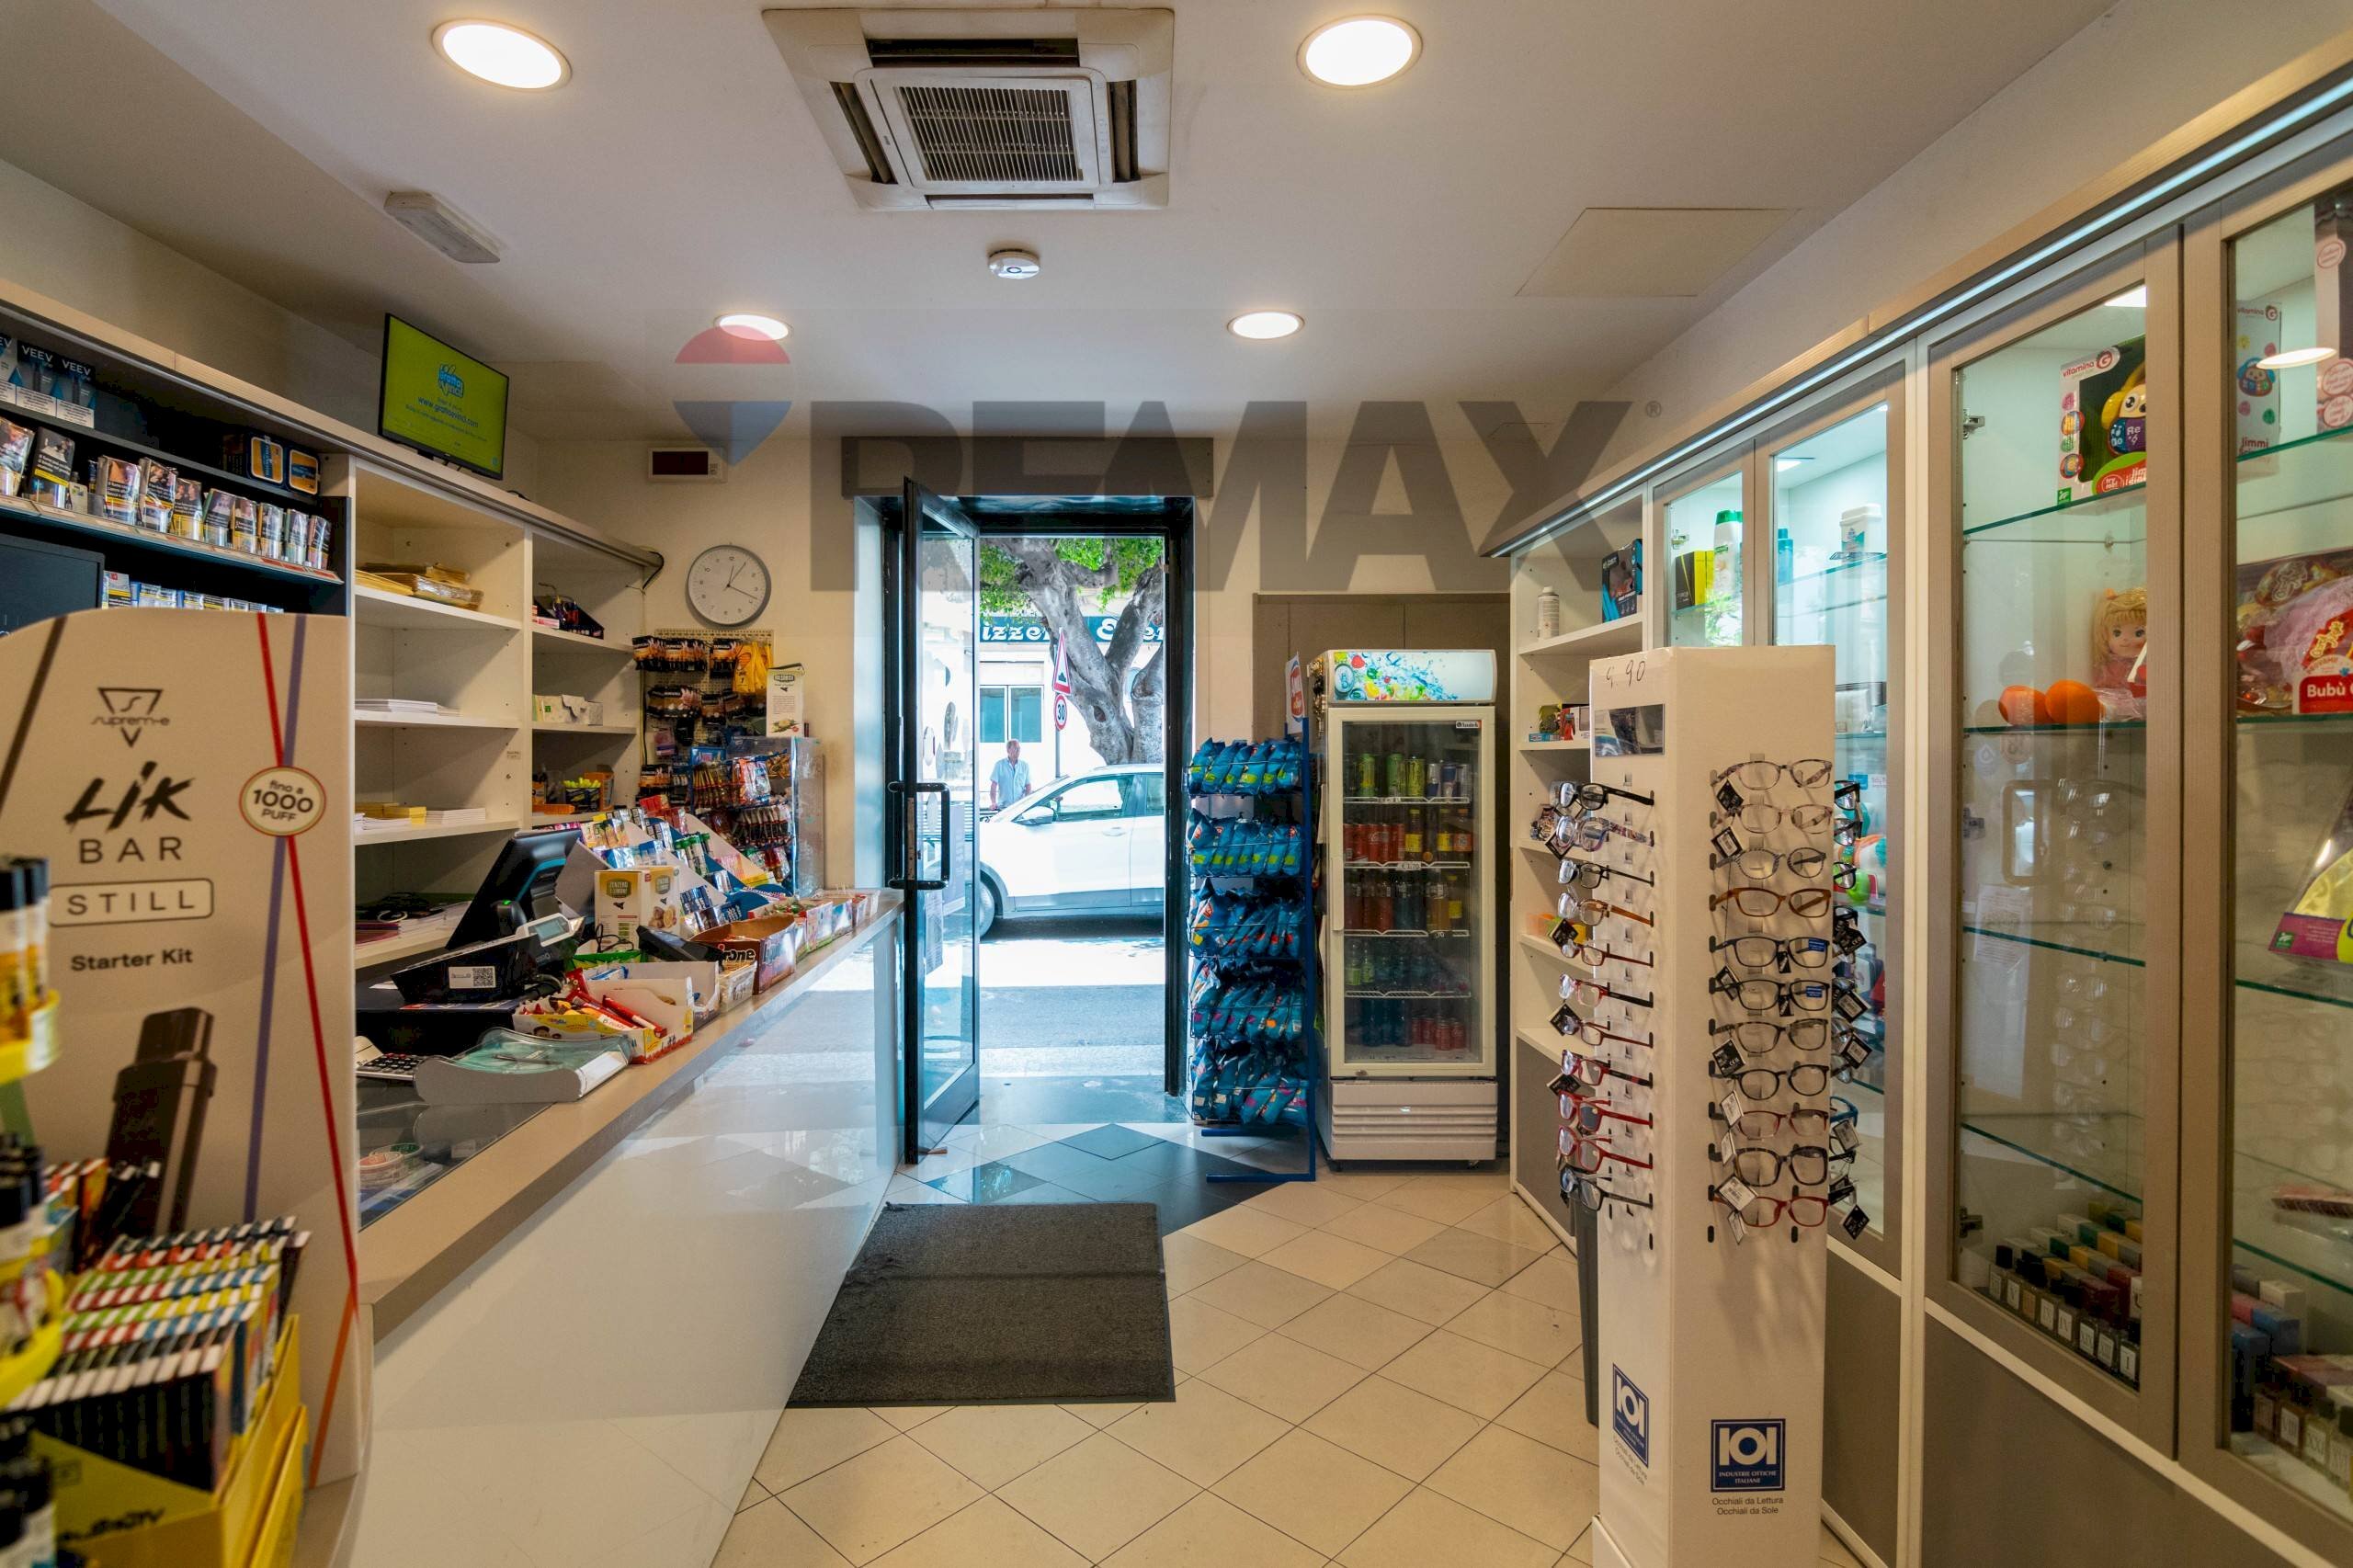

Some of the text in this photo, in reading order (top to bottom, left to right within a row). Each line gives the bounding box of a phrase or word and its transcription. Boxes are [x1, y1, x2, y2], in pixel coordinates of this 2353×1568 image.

[21, 345, 53, 363] VEEV
[62, 358, 91, 376] VEEV
[2063, 361, 2095, 378] vitamina
[2307, 682, 2346, 698] Bubù
[1057, 704, 1065, 720] 30
[254, 790, 313, 812] 1000
[261, 809, 297, 821] PUFF
[79, 836, 182, 864] BAR
[67, 890, 196, 916] STILL
[71, 948, 193, 971] Starter Kit
[1711, 1497, 1744, 1506] Occhiali
[1756, 1496, 1784, 1505] Lettura
[1716, 1506, 1779, 1516] Occhiali da Sole
